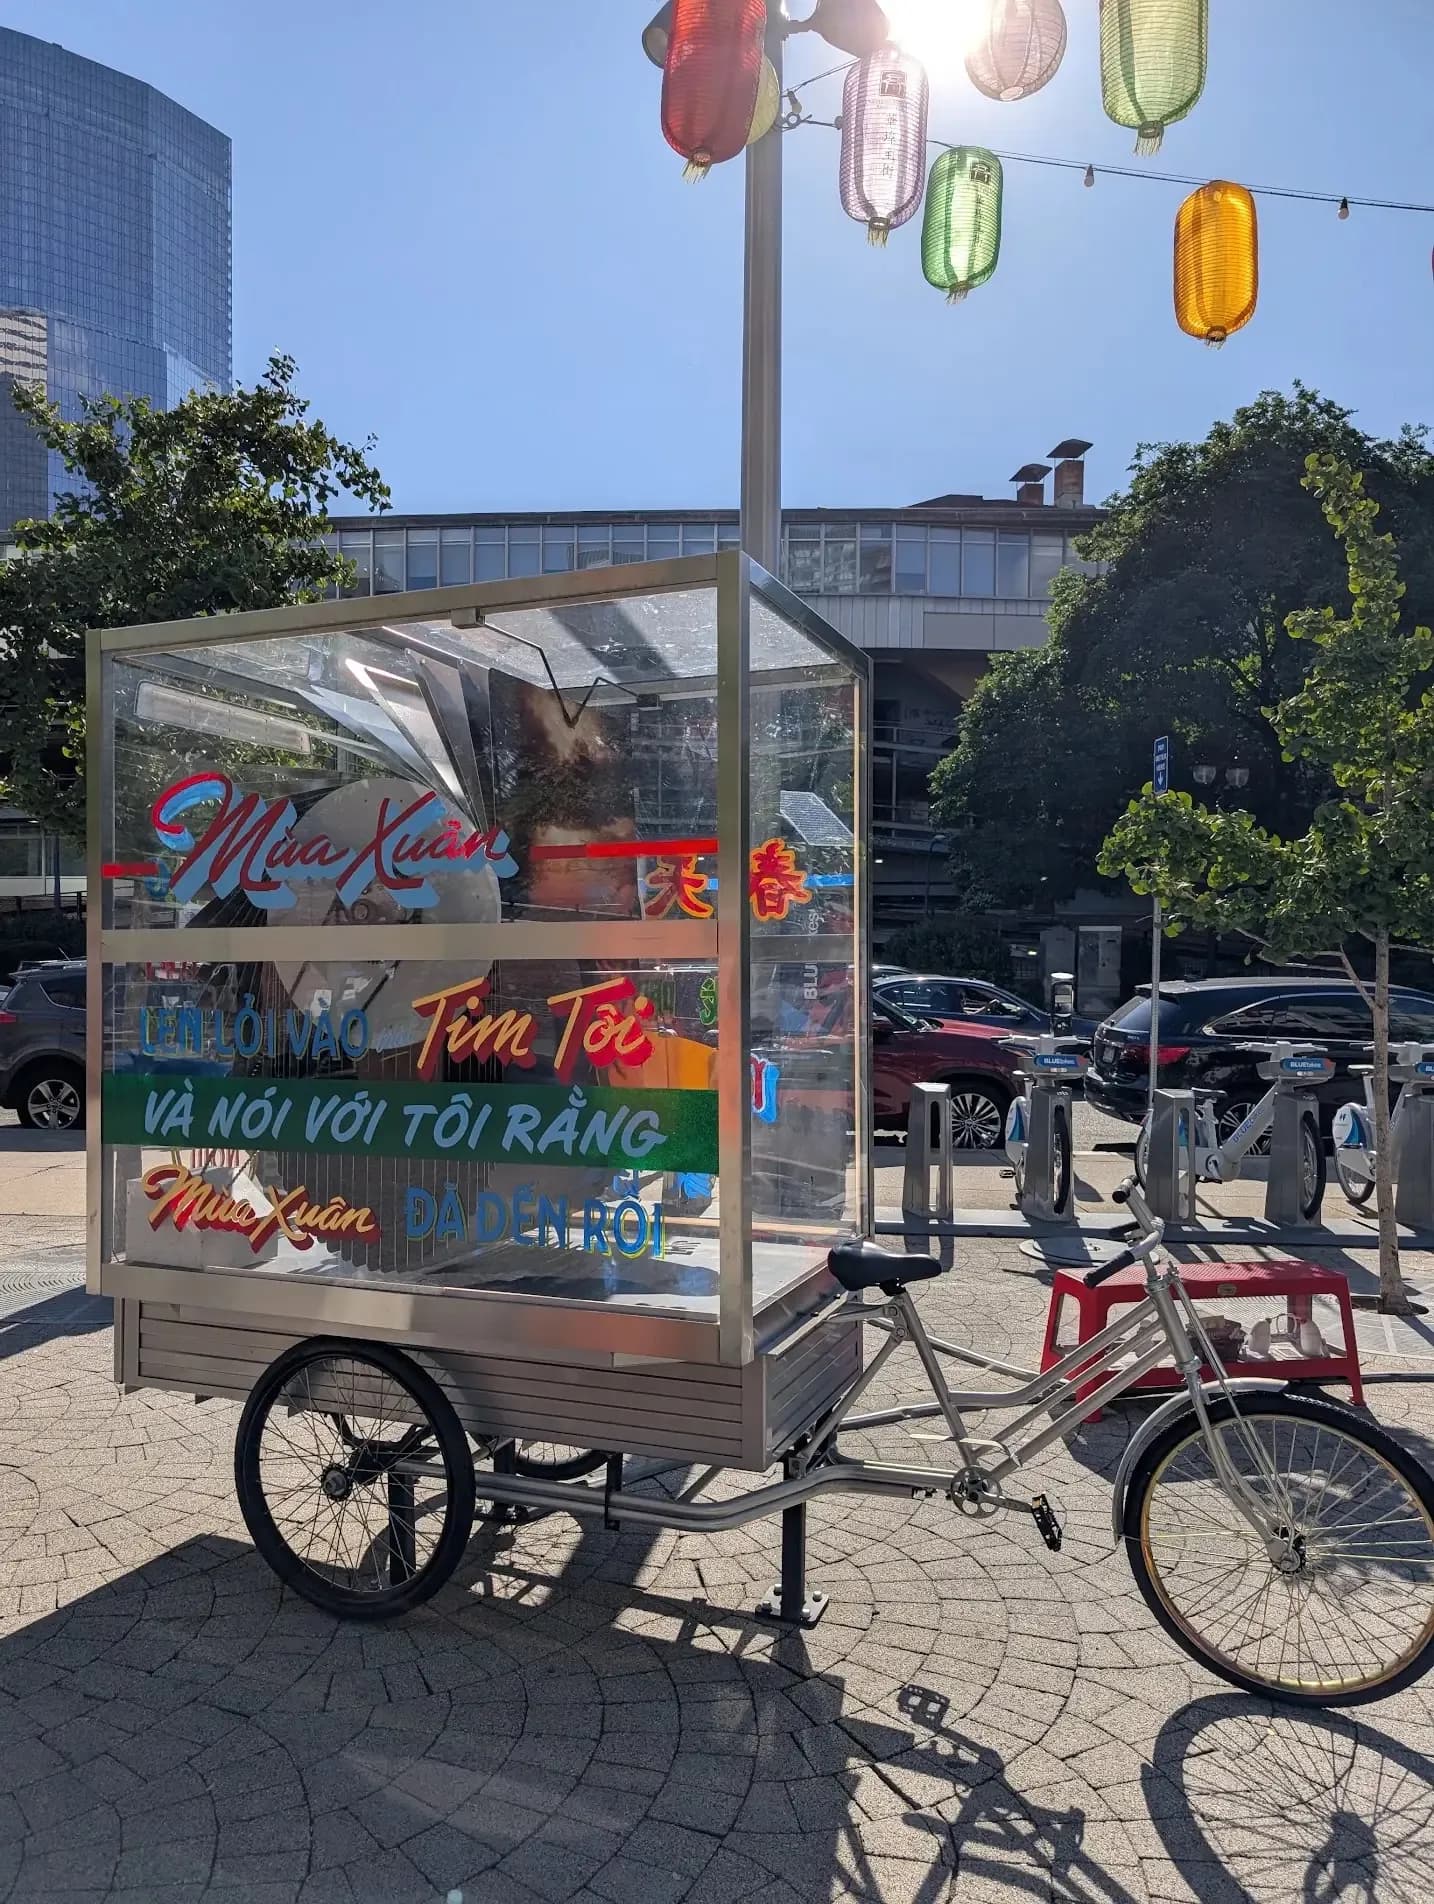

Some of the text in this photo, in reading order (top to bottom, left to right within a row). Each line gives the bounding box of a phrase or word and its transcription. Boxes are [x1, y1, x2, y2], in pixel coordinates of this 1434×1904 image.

[151, 771, 518, 903] Mùa Xuân
[411, 976, 537, 1079] Tim
[547, 976, 655, 1080] Tôi
[144, 1078, 668, 1158] VÀ NÓI VỚI TÔI RẰNG
[142, 1163, 257, 1236] Mùa
[248, 1184, 383, 1254] Xuân
